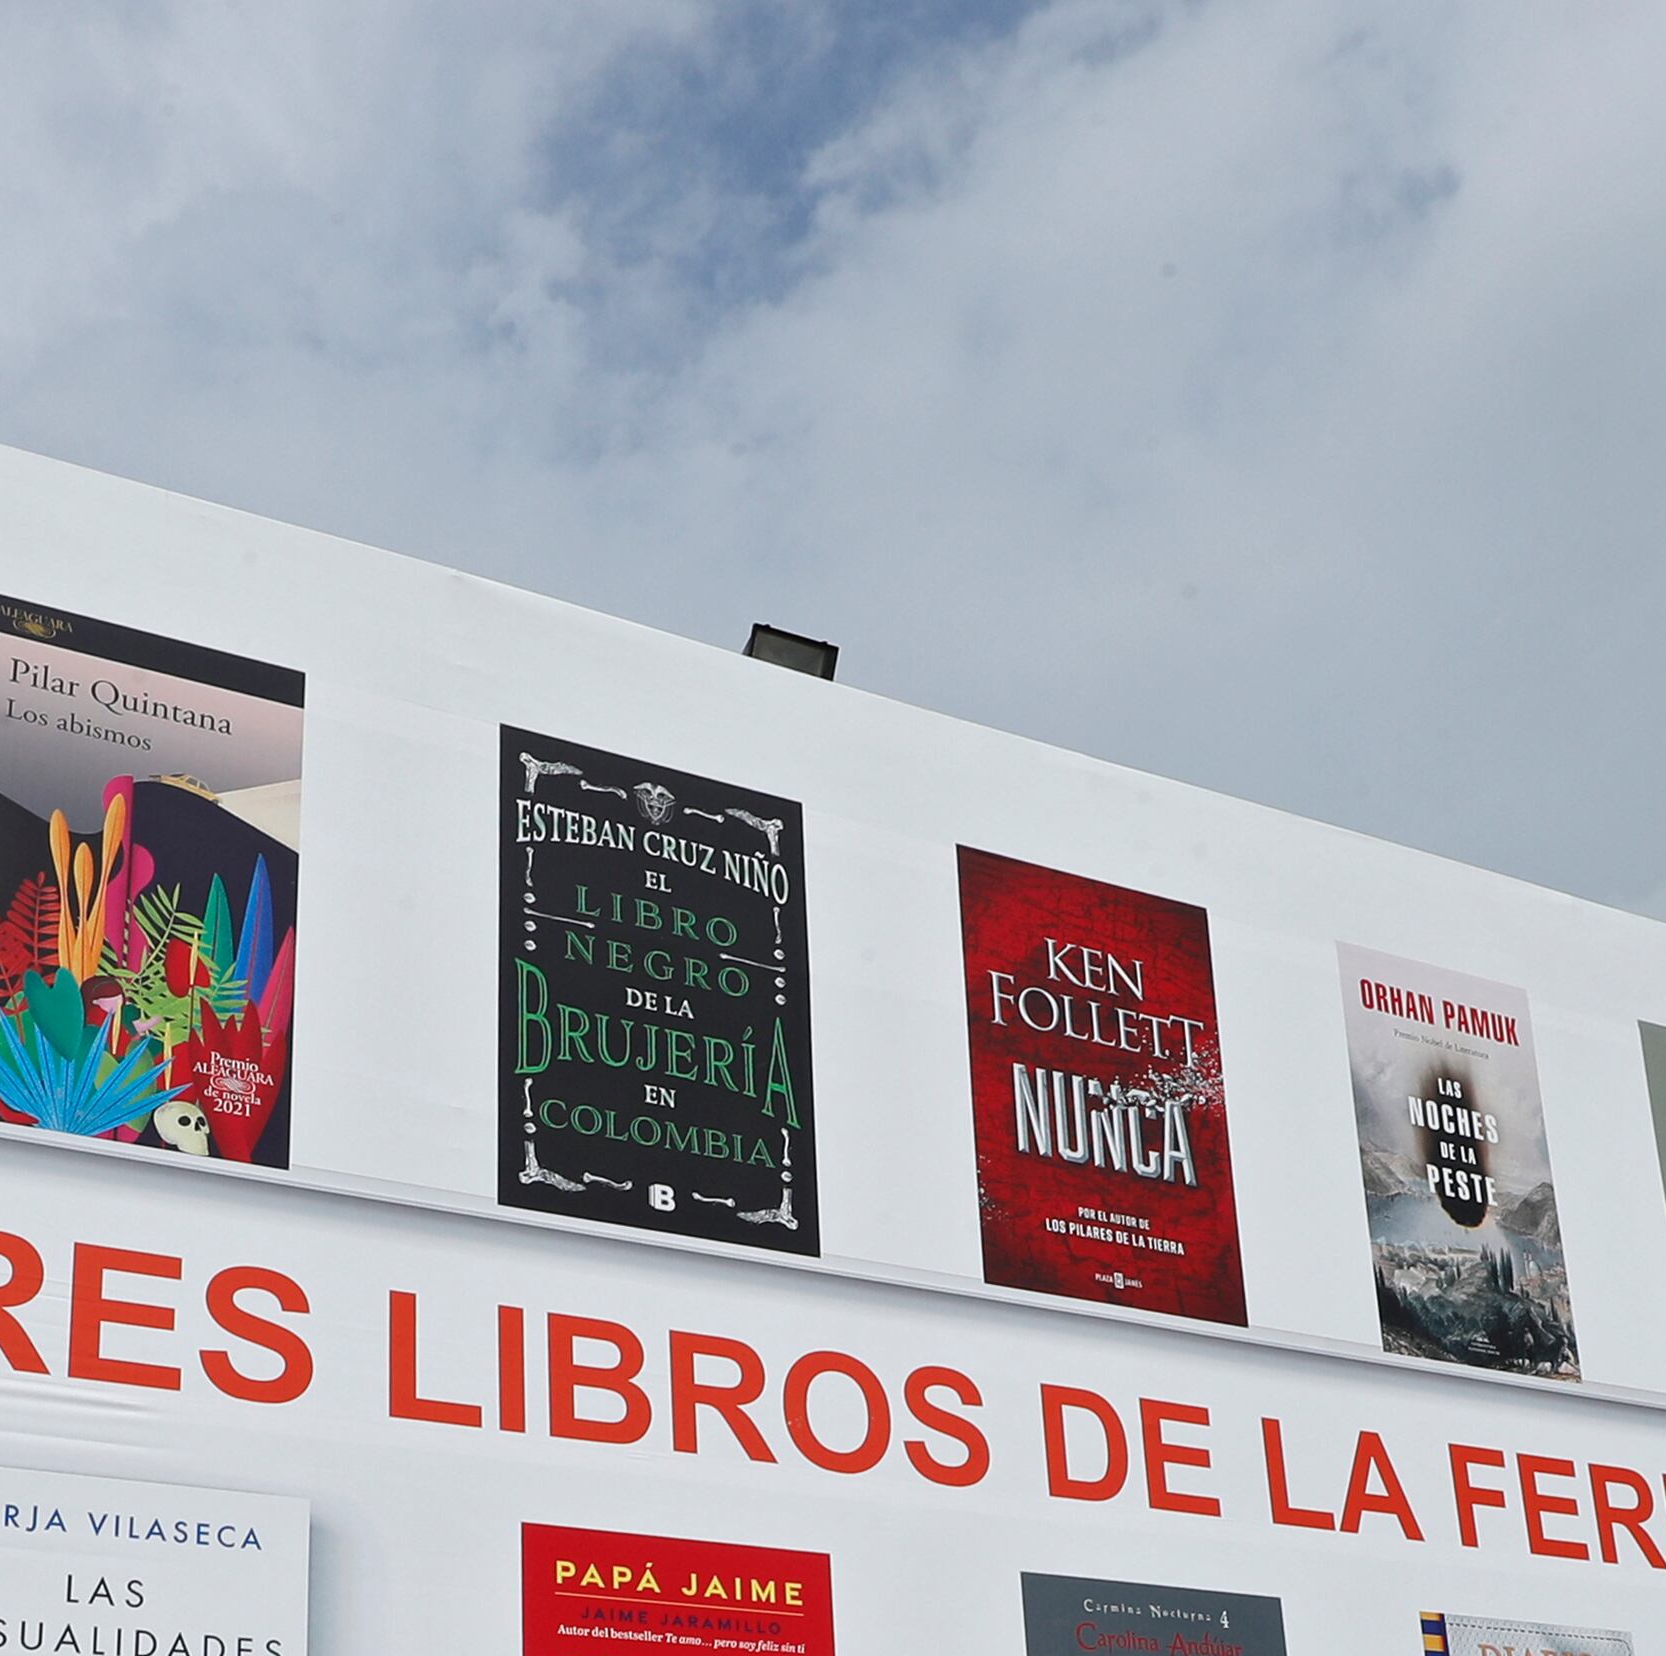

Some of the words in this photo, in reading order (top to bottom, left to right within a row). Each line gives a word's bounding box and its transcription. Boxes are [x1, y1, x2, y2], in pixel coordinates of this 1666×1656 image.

[9, 657, 80, 698] Pilar
[90, 679, 232, 736] Quintana
[5, 699, 48, 727] Los
[57, 713, 152, 751] abismos
[515, 799, 636, 851] ESTEBAN
[643, 831, 716, 874] CRUZ
[722, 852, 789, 904] NIÑO
[644, 870, 672, 893] EL
[575, 884, 738, 947] LIBRO
[565, 930, 750, 997] NEGRO
[1043, 937, 1145, 1001] KEN
[625, 987, 658, 1012] DE
[665, 996, 694, 1019] LA
[987, 969, 1204, 1069] FOLLETT
[1359, 978, 1435, 1026] ORHAN
[1443, 999, 1520, 1047] PAMUK
[210, 1051, 258, 1072] Premio
[514, 957, 801, 1129] BRUJERÍA
[213, 1098, 251, 1117] 2021
[644, 1084, 675, 1108] EN
[1437, 1077, 1462, 1099] LAS
[539, 1099, 776, 1169] COLOMBIA
[1012, 1062, 1198, 1188] NUNCA
[1408, 1096, 1500, 1144] NOCHES
[1440, 1141, 1457, 1161] DE
[1461, 1145, 1477, 1165] LA
[1426, 1164, 1498, 1207] PESTE
[1045, 1218, 1066, 1233] LOS
[1069, 1222, 1113, 1242] PILARES
[1115, 1231, 1130, 1245] DE
[1132, 1234, 1146, 1248] LA
[1147, 1237, 1185, 1255] TIERRA
[388, 1290, 991, 1488] LIBROS
[1040, 1383, 1222, 1518] DE
[1262, 1417, 1425, 1543] LA
[88, 1512, 262, 1551] VILASECA
[66, 1574, 145, 1609] LAS
[555, 1559, 661, 1595] PAPÁ
[681, 1572, 804, 1607] JAIME
[557, 1624, 590, 1637] Autor
[610, 1628, 663, 1643] bestseller
[660, 1613, 782, 1635] JARAMILLO
[1075, 1622, 1160, 1655] Carolina
